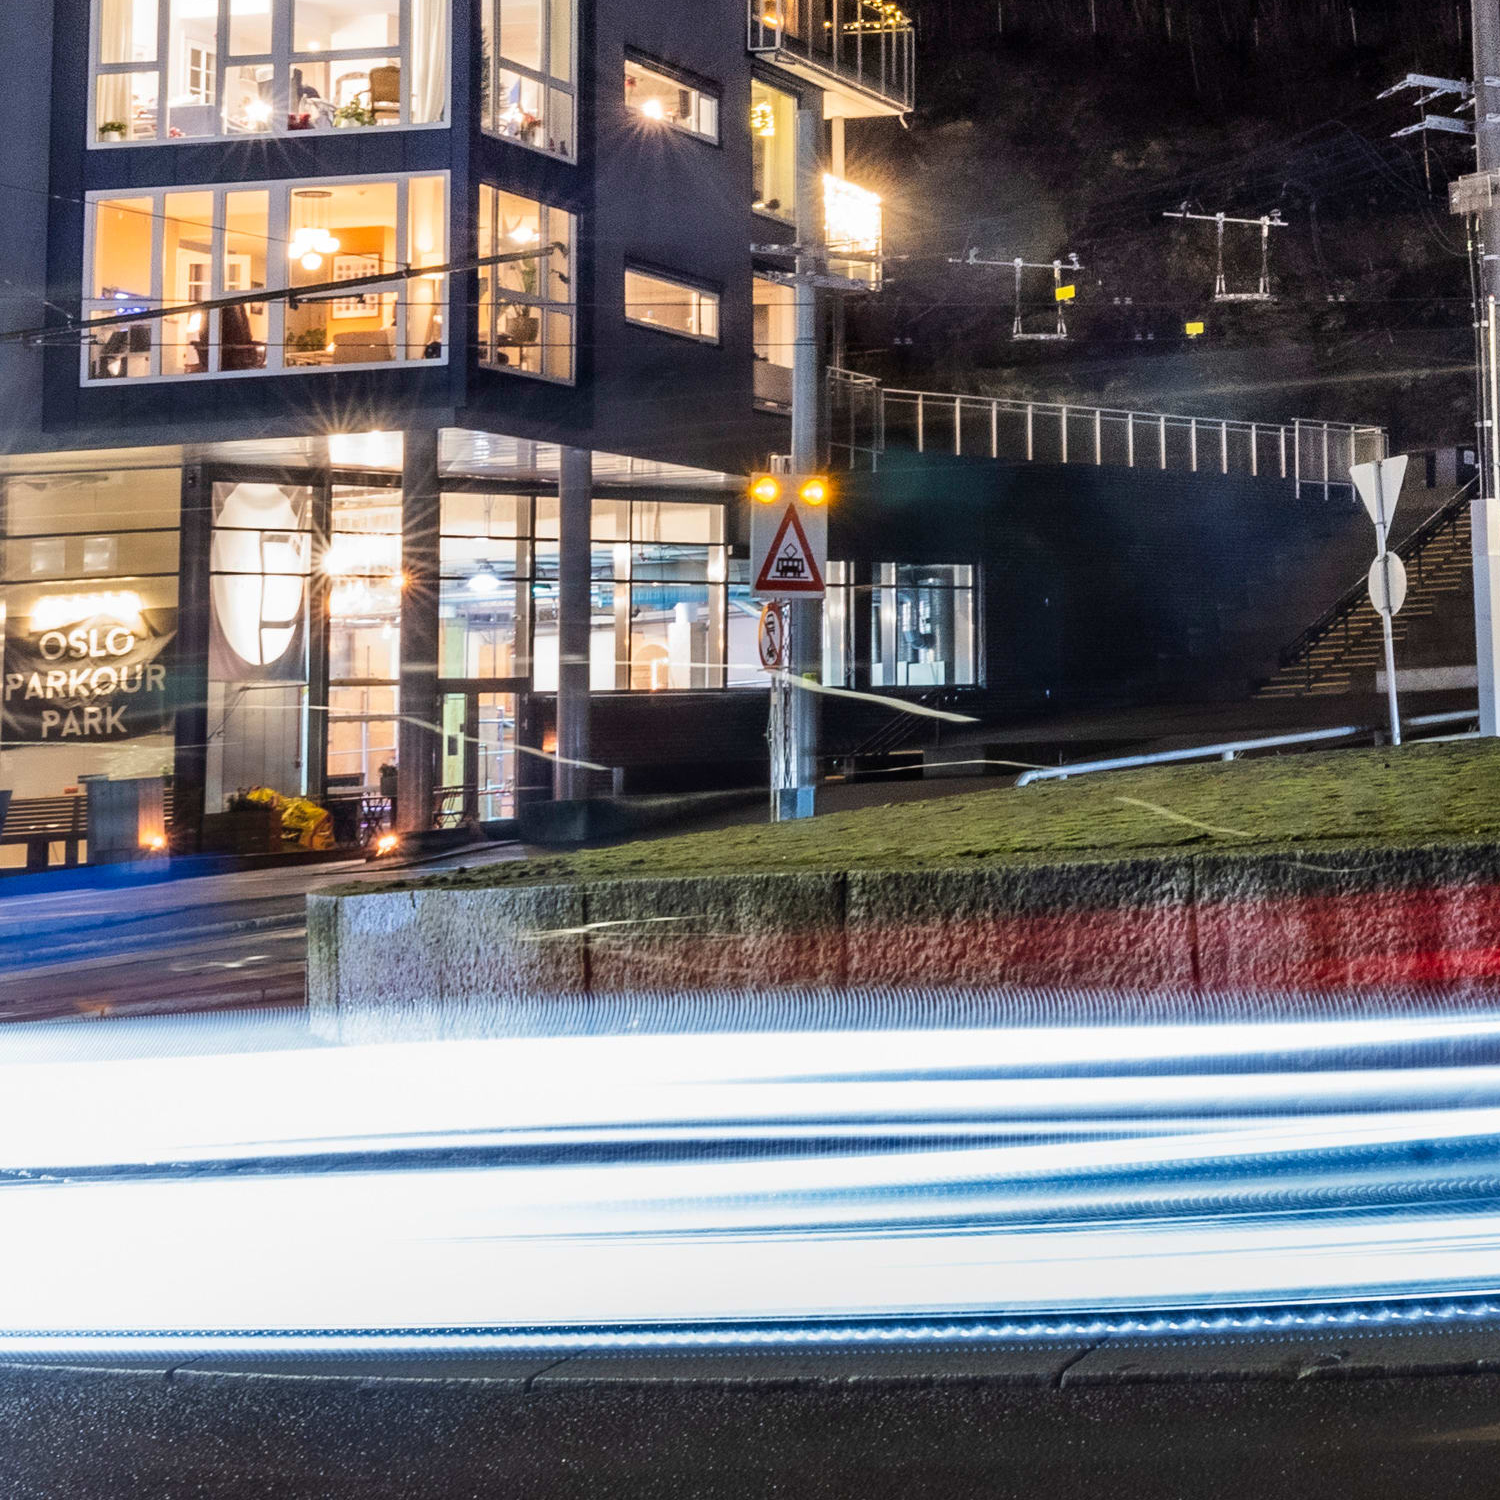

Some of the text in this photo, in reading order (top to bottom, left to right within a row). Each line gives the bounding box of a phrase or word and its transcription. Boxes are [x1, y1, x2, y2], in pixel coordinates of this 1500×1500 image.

[39, 626, 135, 661] OSLO
[5, 663, 167, 701] PARKOUR
[41, 704, 129, 739] PARK
